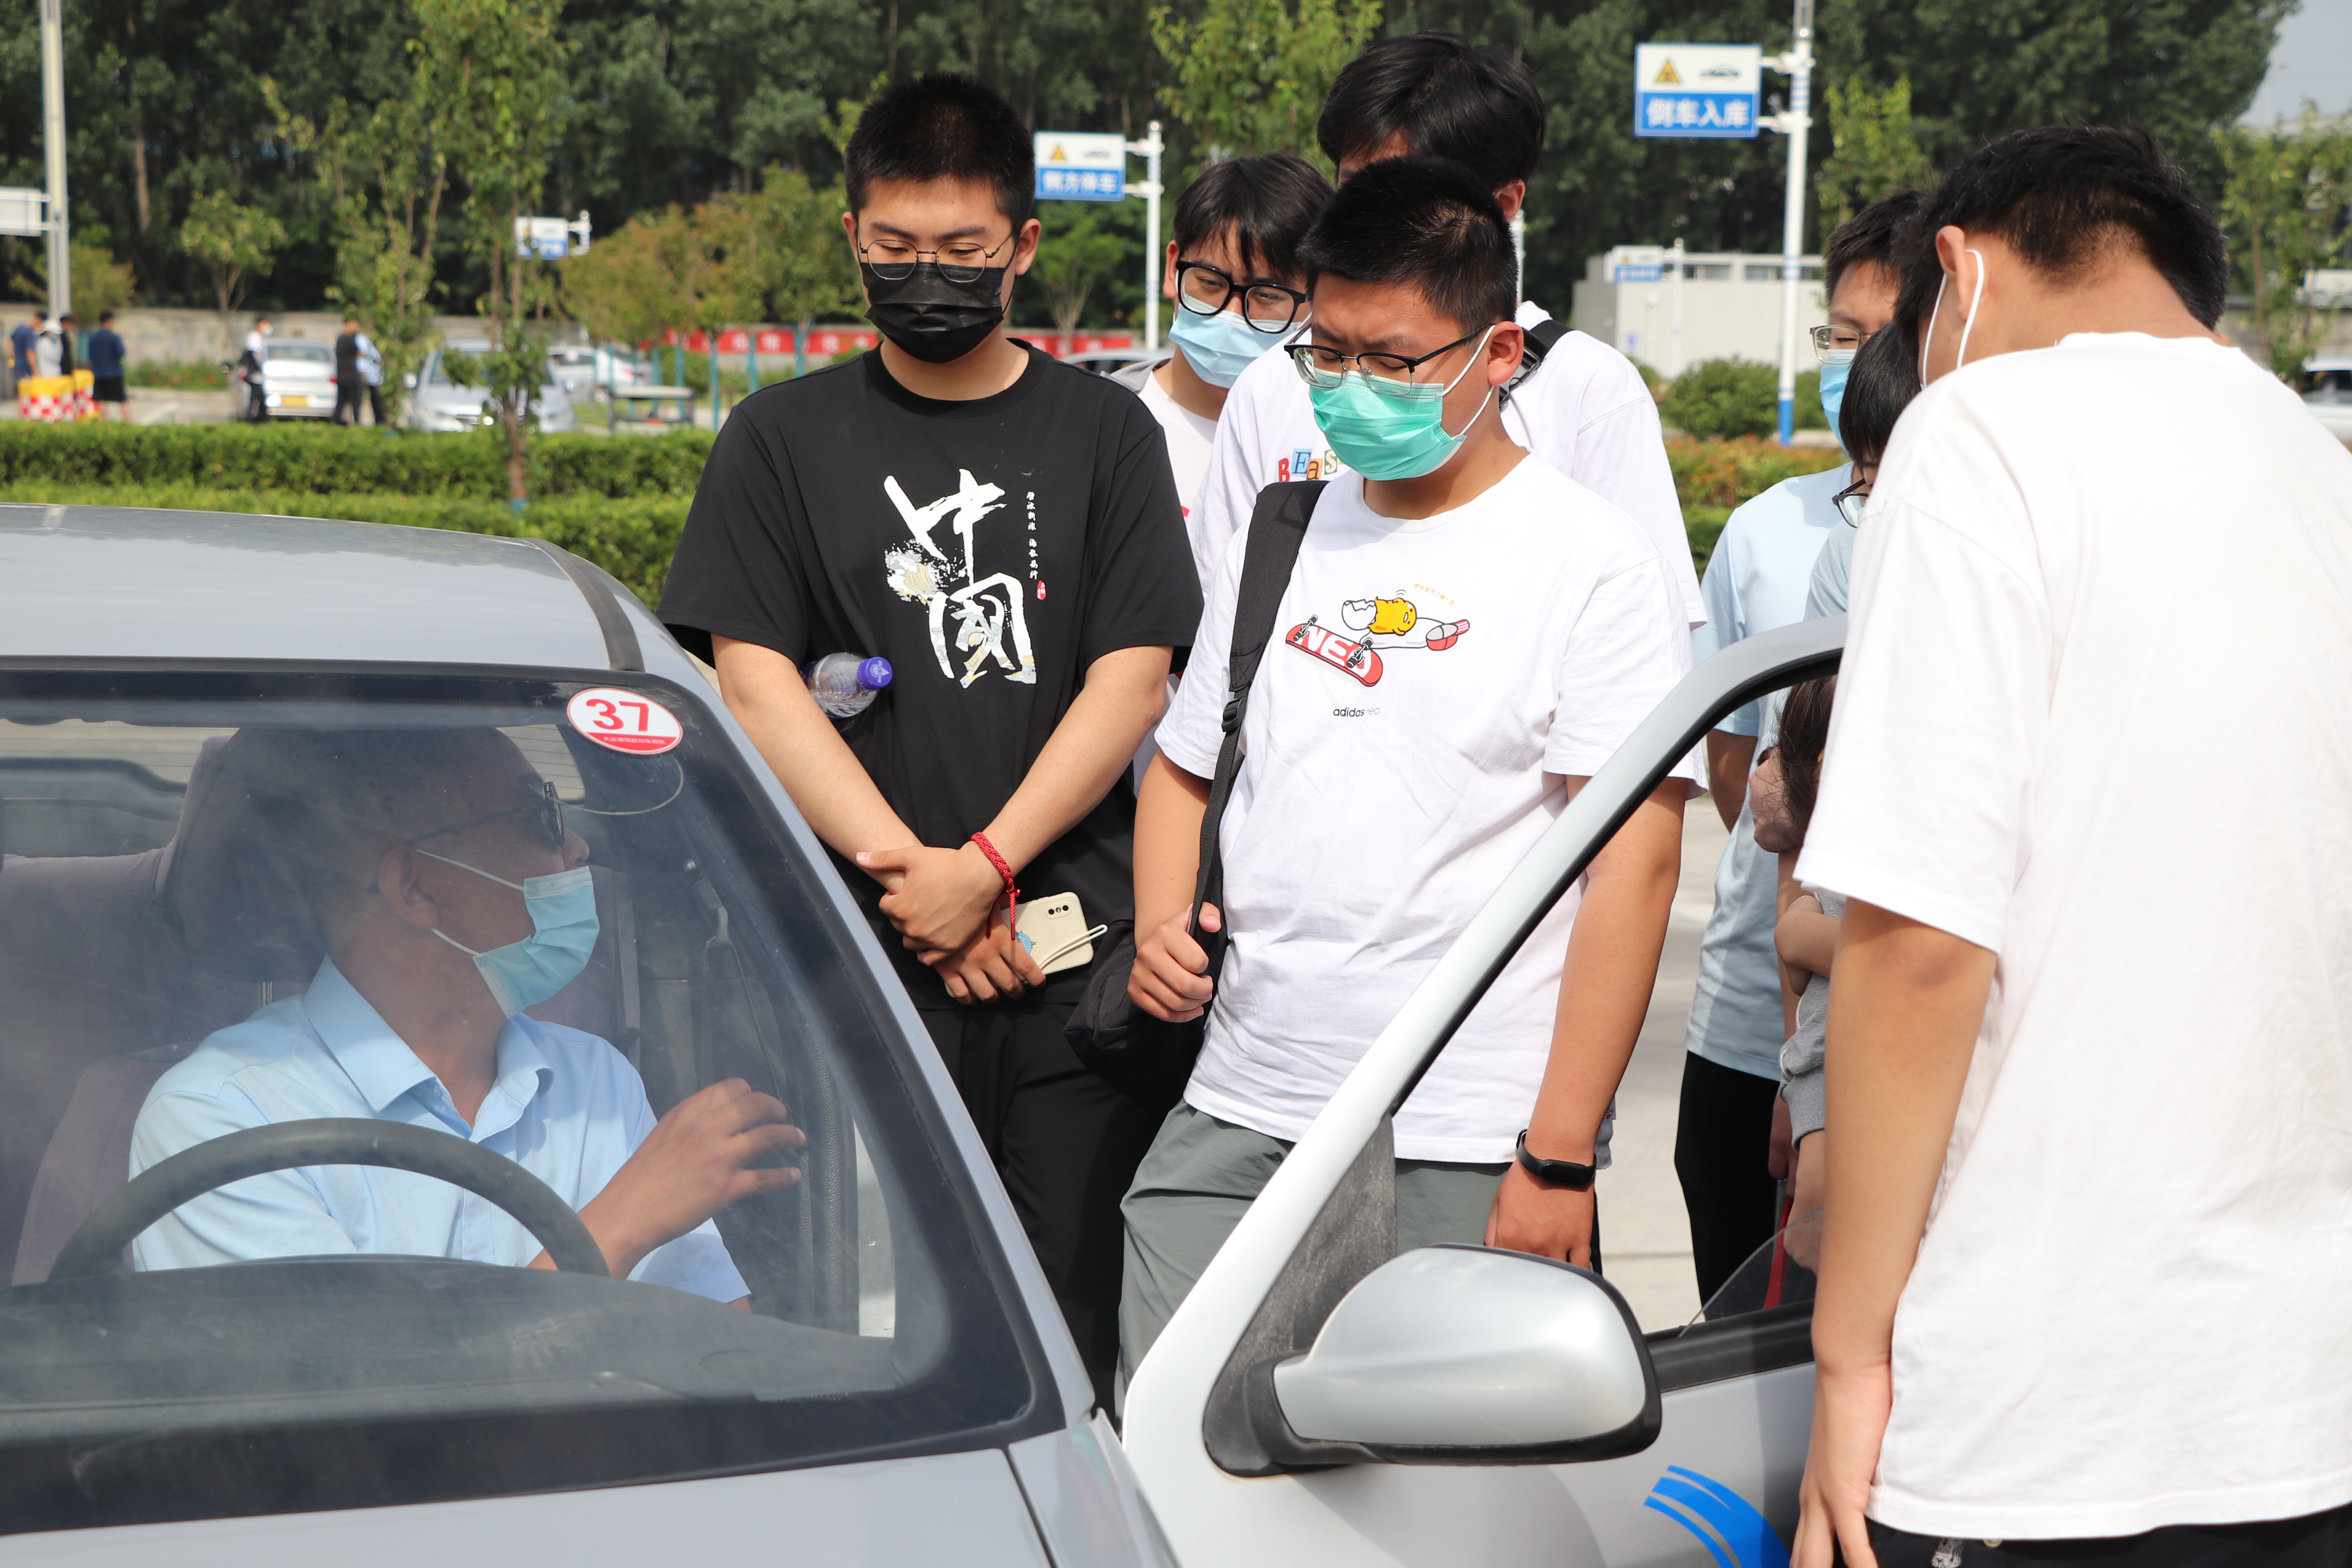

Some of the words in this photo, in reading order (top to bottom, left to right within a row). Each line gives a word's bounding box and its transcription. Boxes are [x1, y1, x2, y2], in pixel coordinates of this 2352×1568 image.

[1647, 98, 1749, 128] 倒车入库
[1294, 626, 1371, 679] NEO
[586, 699, 650, 732] 37
[1333, 707, 1365, 717] adidas
[1365, 708, 1380, 716] neo
